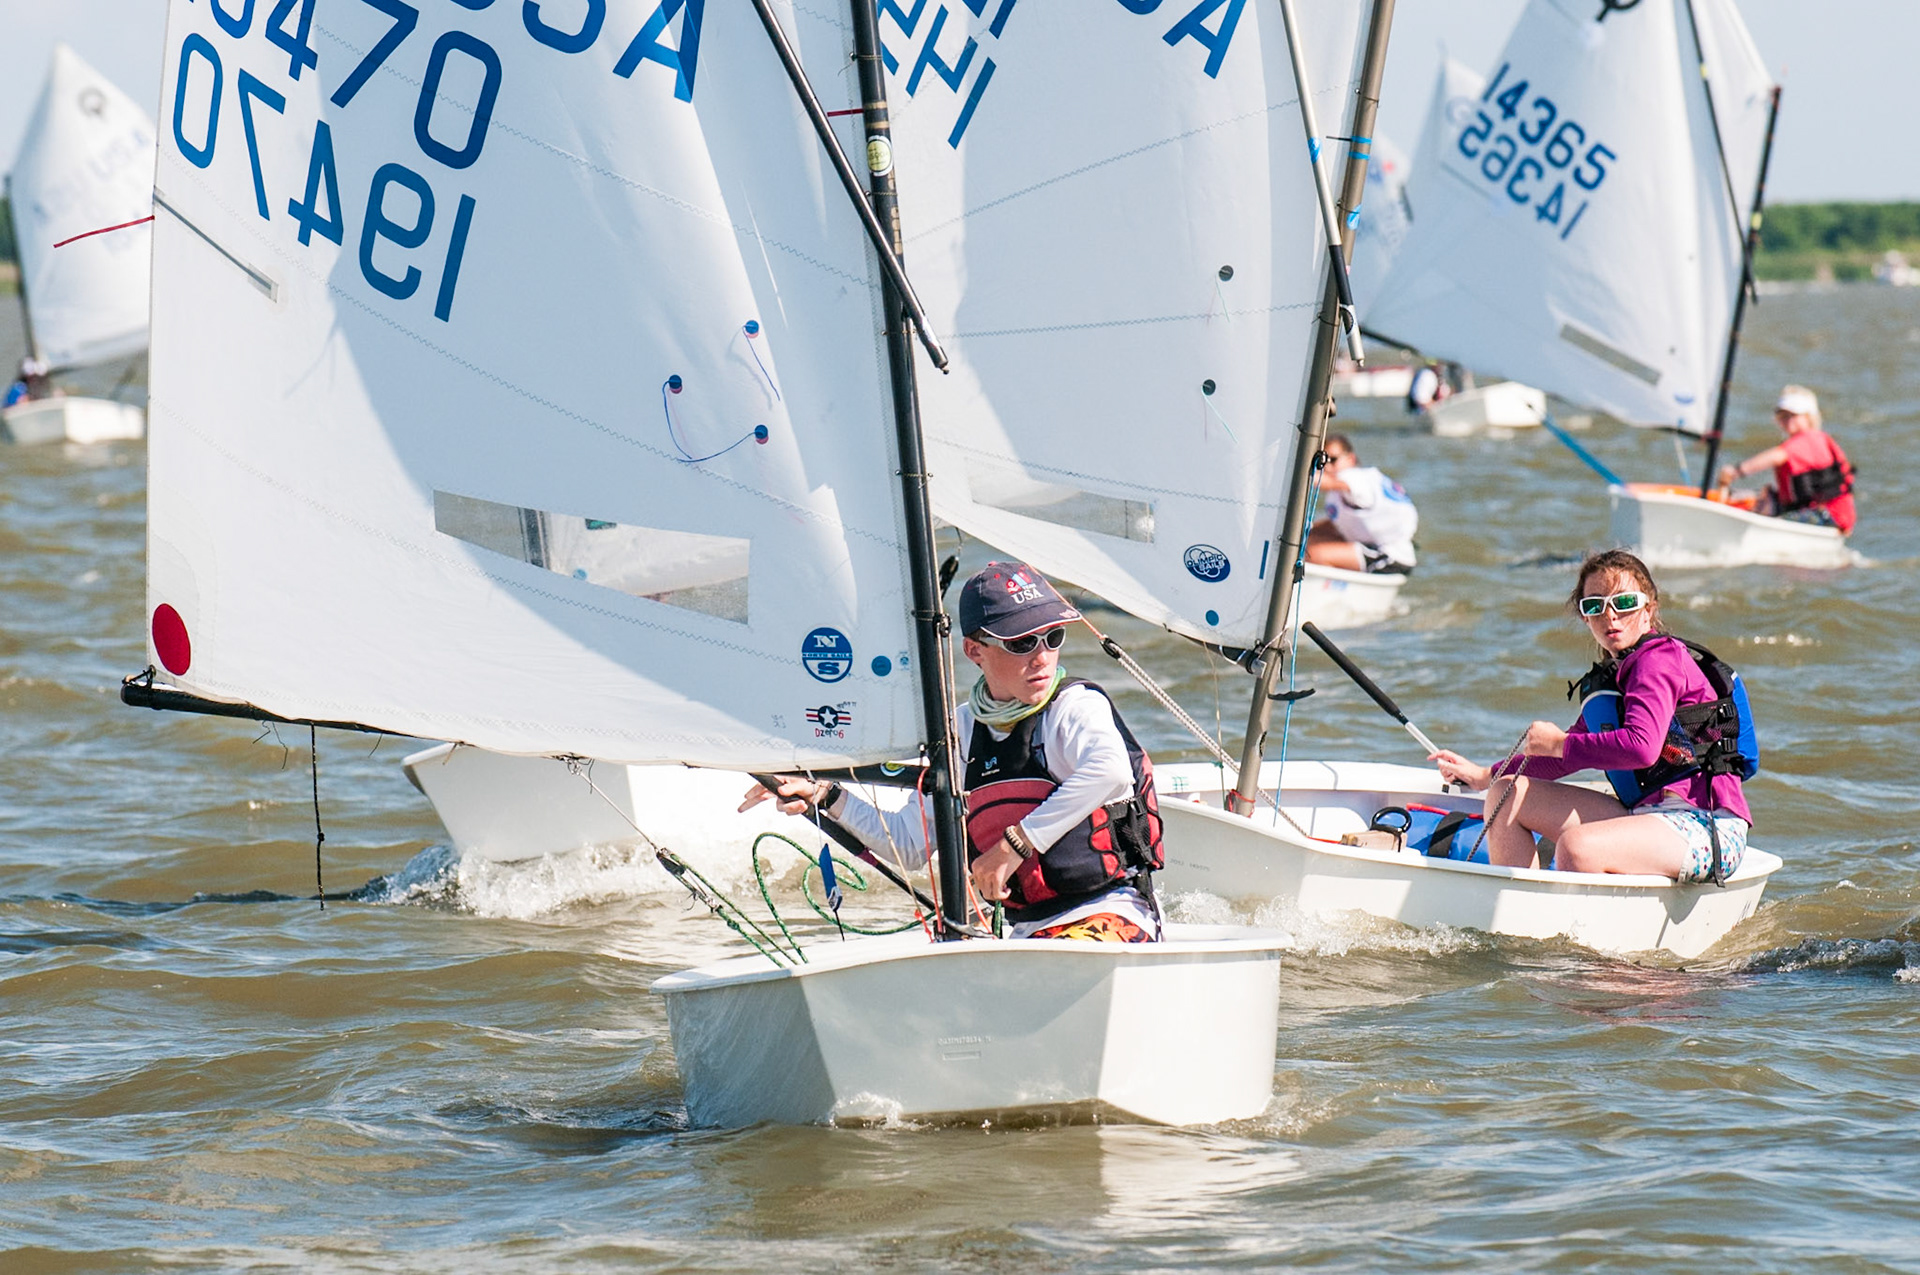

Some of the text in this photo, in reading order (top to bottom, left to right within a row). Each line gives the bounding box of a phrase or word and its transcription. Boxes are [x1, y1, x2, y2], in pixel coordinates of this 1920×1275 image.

[1482, 61, 1617, 191] 14365
[1011, 588, 1044, 604] USA
[813, 635, 840, 648] N
[817, 661, 840, 676] S
